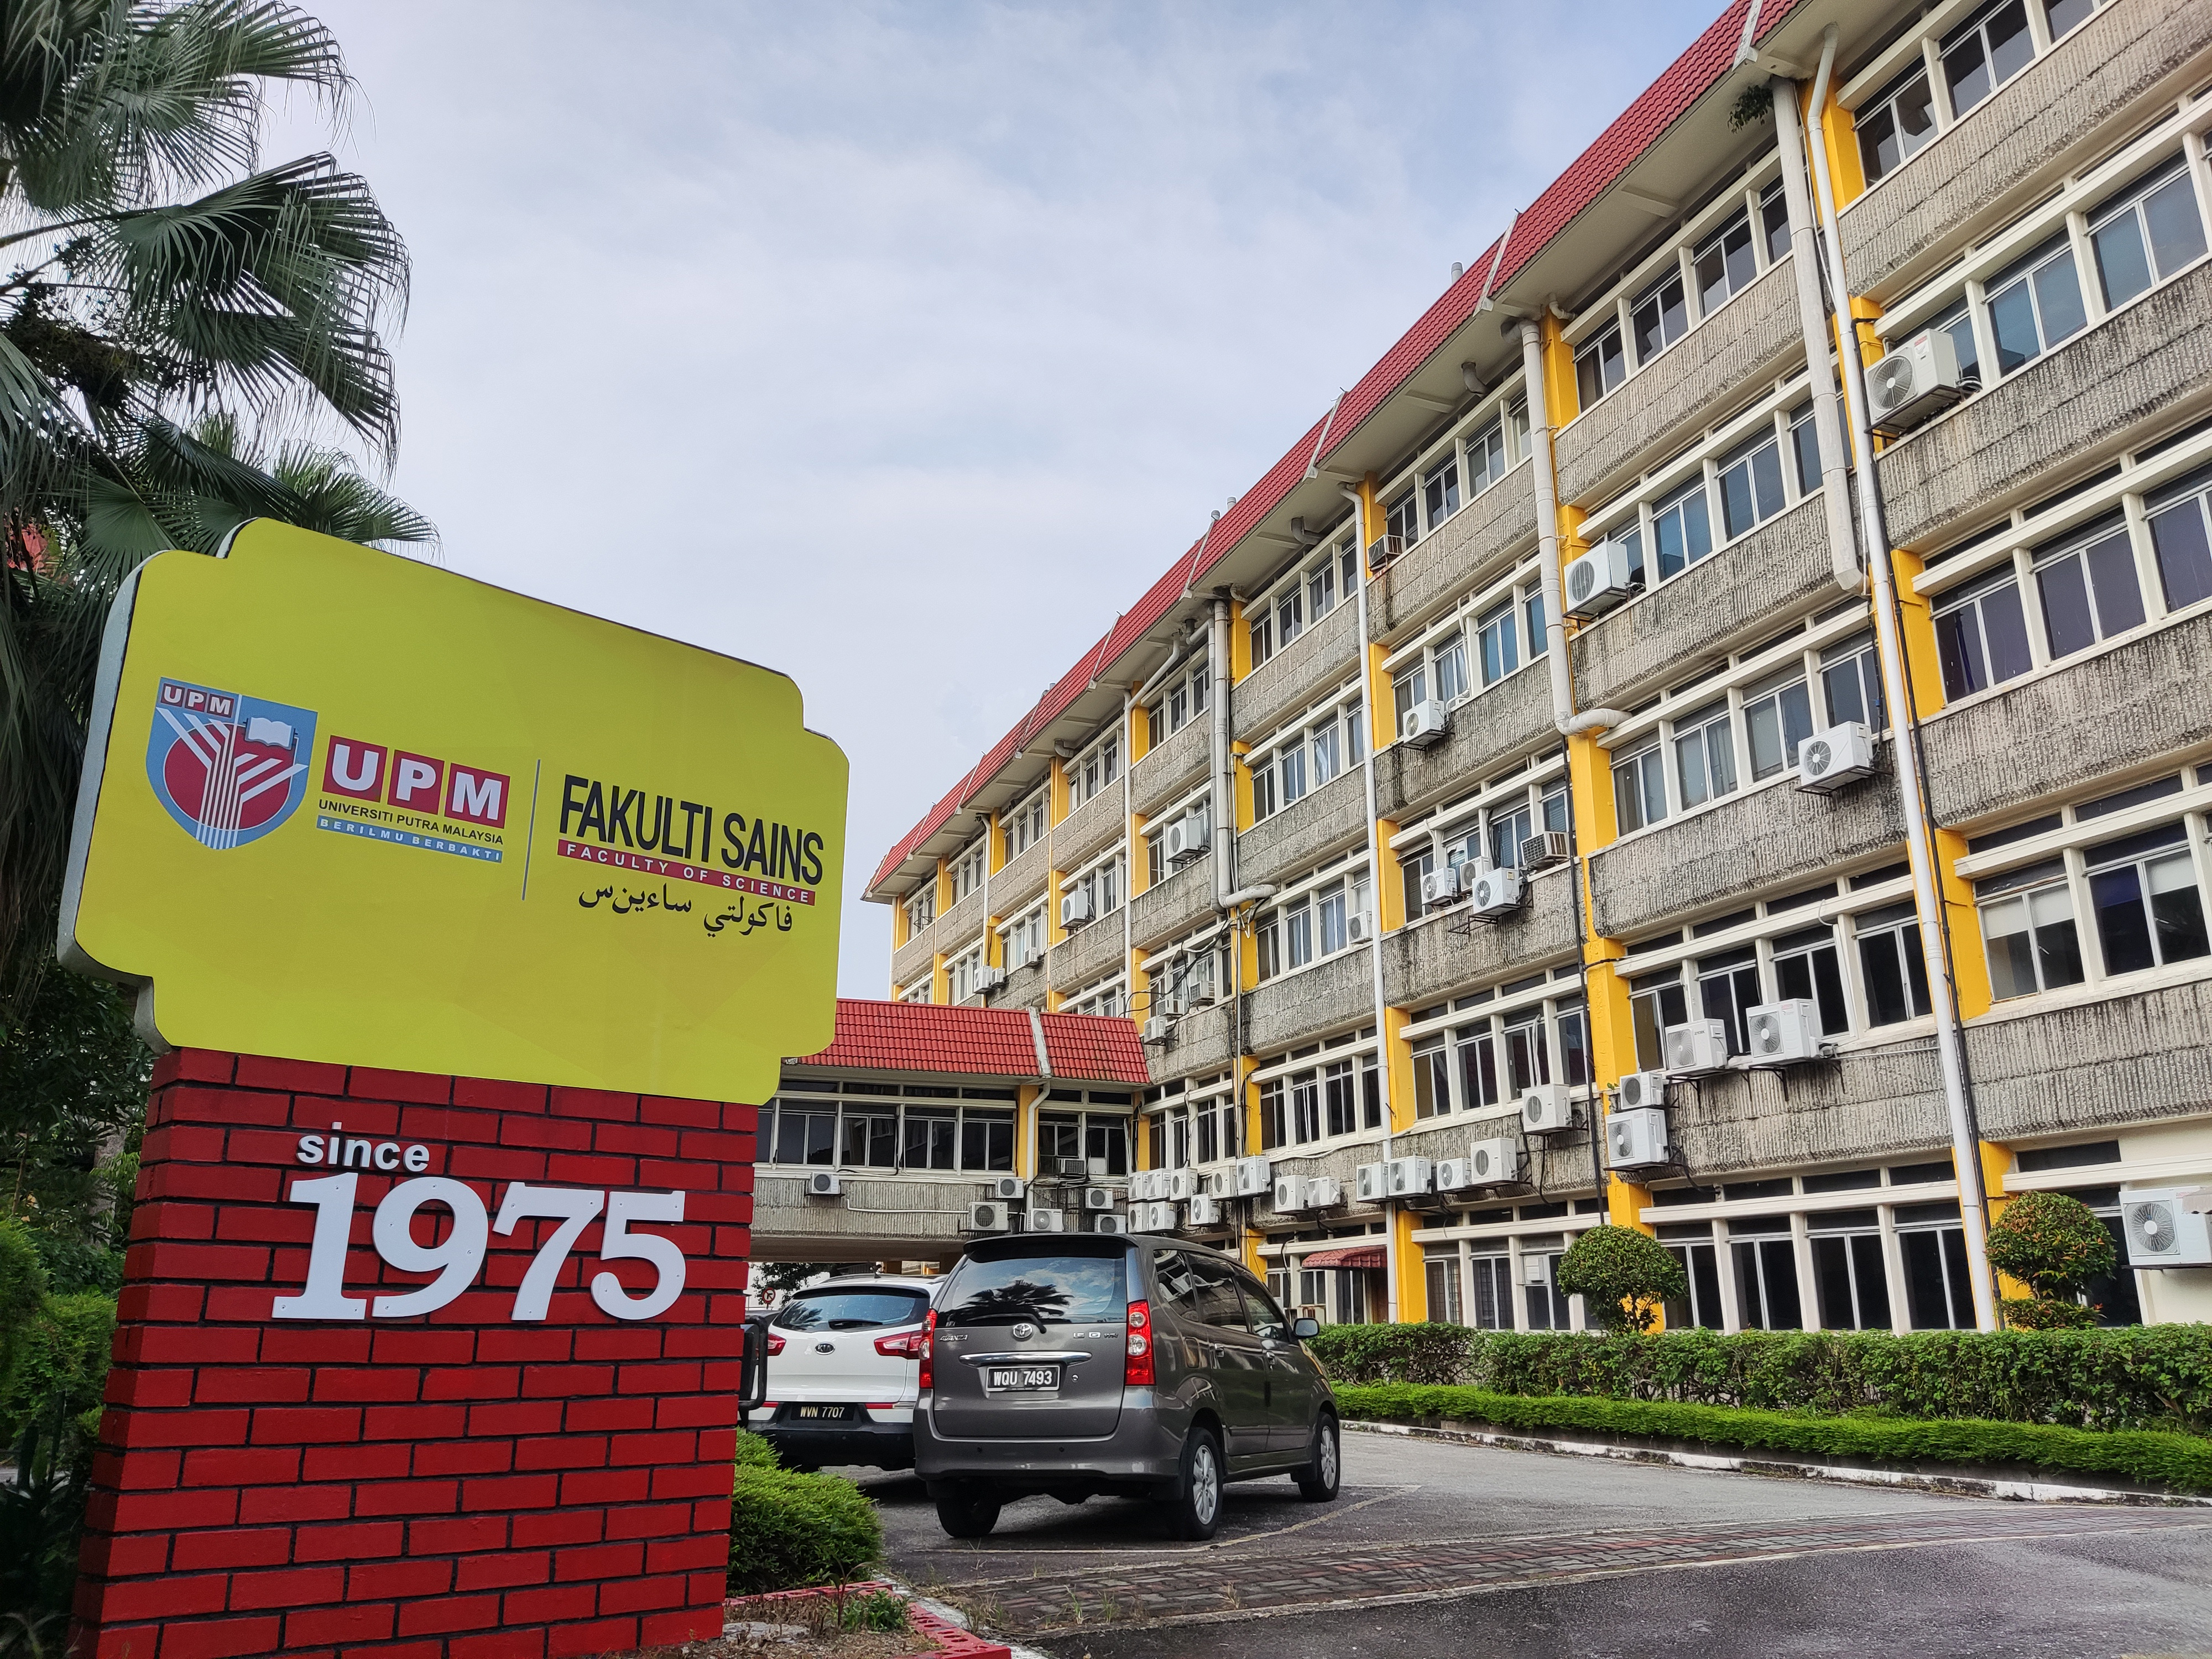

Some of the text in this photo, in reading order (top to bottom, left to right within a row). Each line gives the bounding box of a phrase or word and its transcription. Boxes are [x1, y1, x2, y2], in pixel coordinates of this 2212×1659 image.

[164, 686, 232, 715] UPM
[332, 743, 502, 821] UPM
[319, 799, 504, 845] UNIVERSITI PUTRA MALAYSIA
[320, 818, 500, 860] BERILMU BERBAKTI
[559, 774, 823, 885] FAKULTI SAINS
[567, 844, 809, 903] FACULTY OF SCIENCE
[296, 1122, 430, 1172] since
[271, 1172, 687, 1321] 1975
[994, 1370, 1052, 1386] WQU 7493
[800, 1406, 845, 1418] WVN 7707
